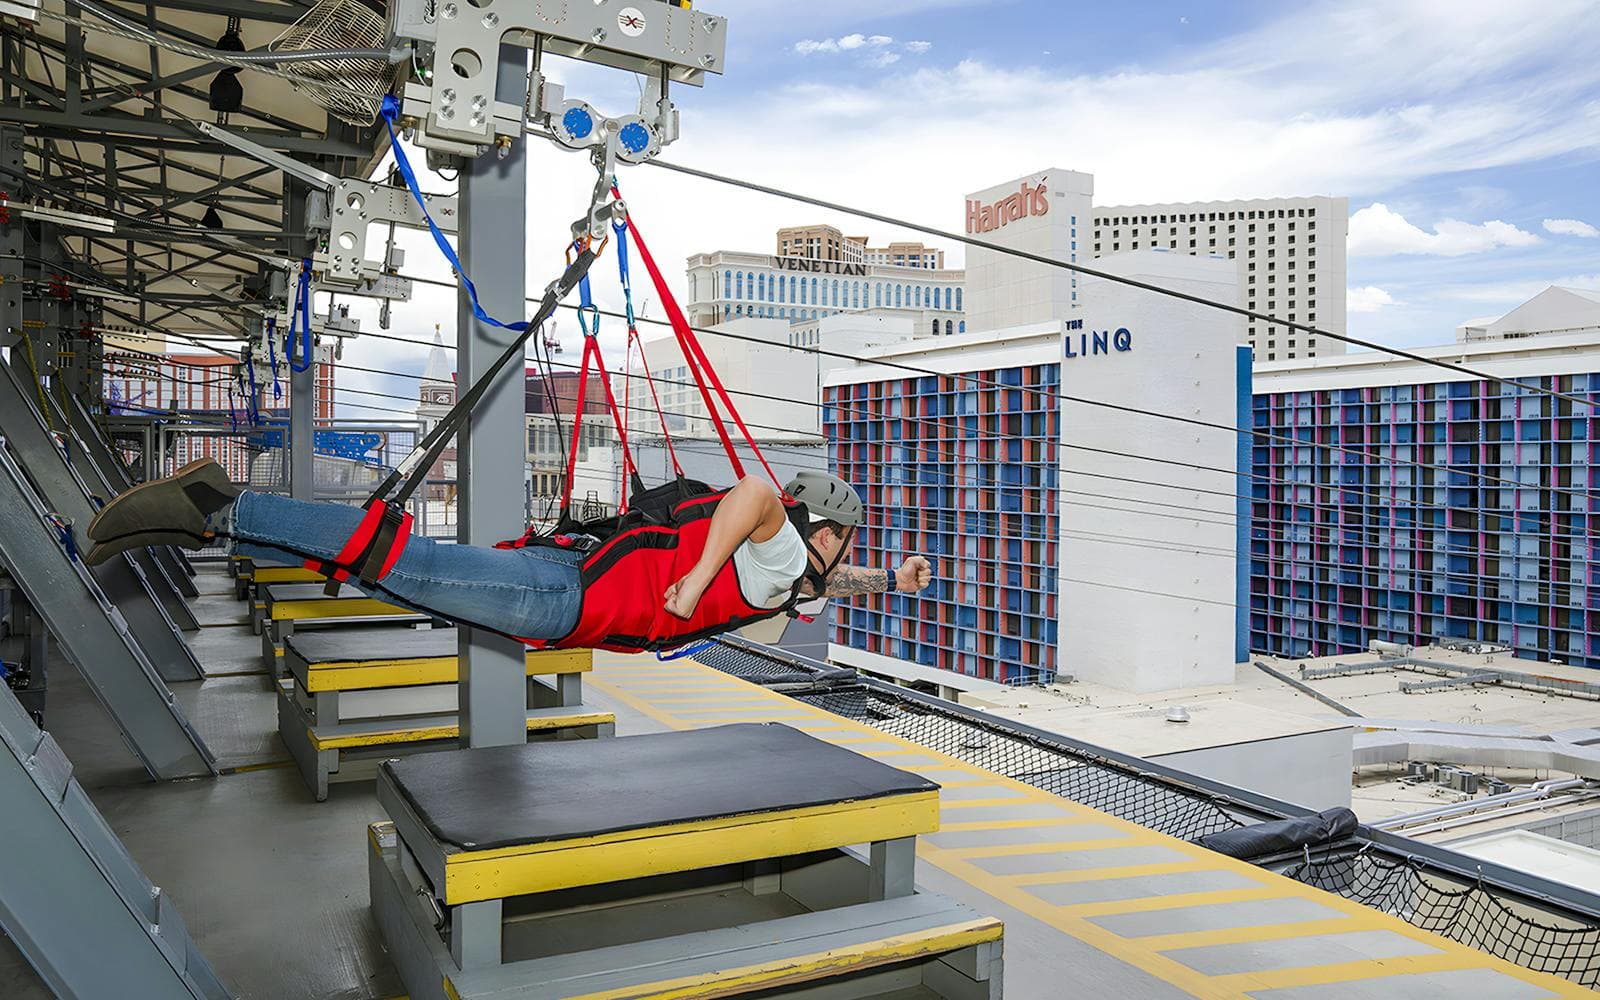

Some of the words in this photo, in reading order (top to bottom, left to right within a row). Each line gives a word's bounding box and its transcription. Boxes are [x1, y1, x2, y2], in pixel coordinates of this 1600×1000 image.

[966, 180, 1048, 234] Harrah's
[775, 256, 866, 276] VENETIAN
[1065, 319, 1083, 330] THE
[1065, 327, 1132, 358] LINQ
